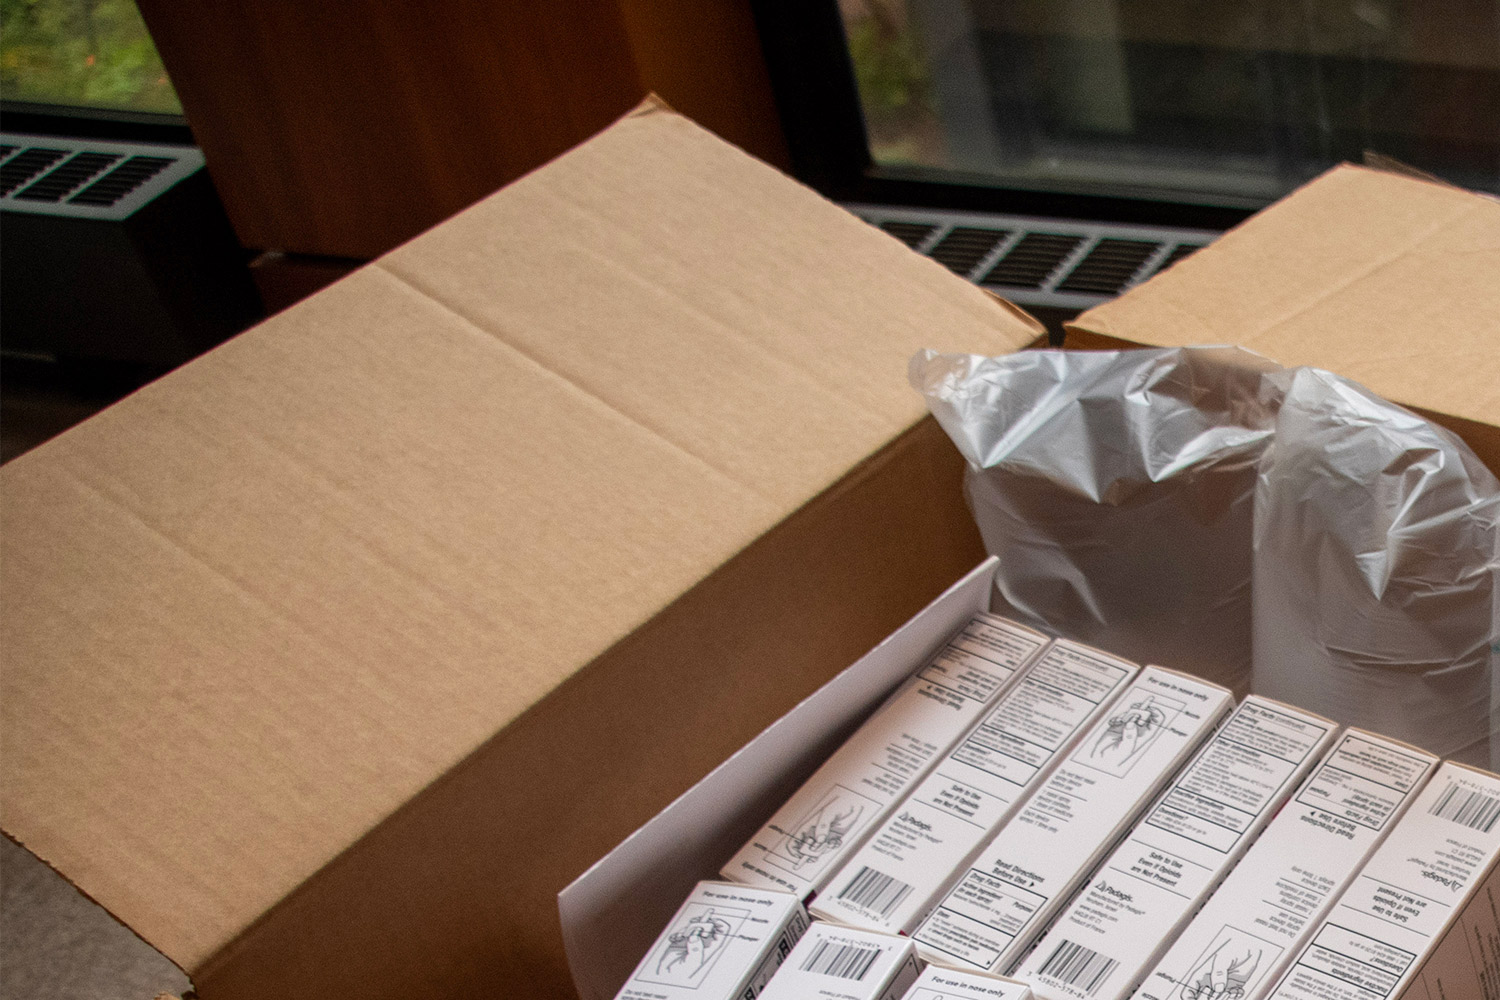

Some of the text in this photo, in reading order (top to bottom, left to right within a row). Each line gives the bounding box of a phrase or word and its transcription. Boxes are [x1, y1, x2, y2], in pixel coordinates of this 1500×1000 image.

[931, 976, 944, 984] For
[944, 979, 958, 987] use
[968, 984, 986, 993] nose
[987, 988, 1005, 998] only
